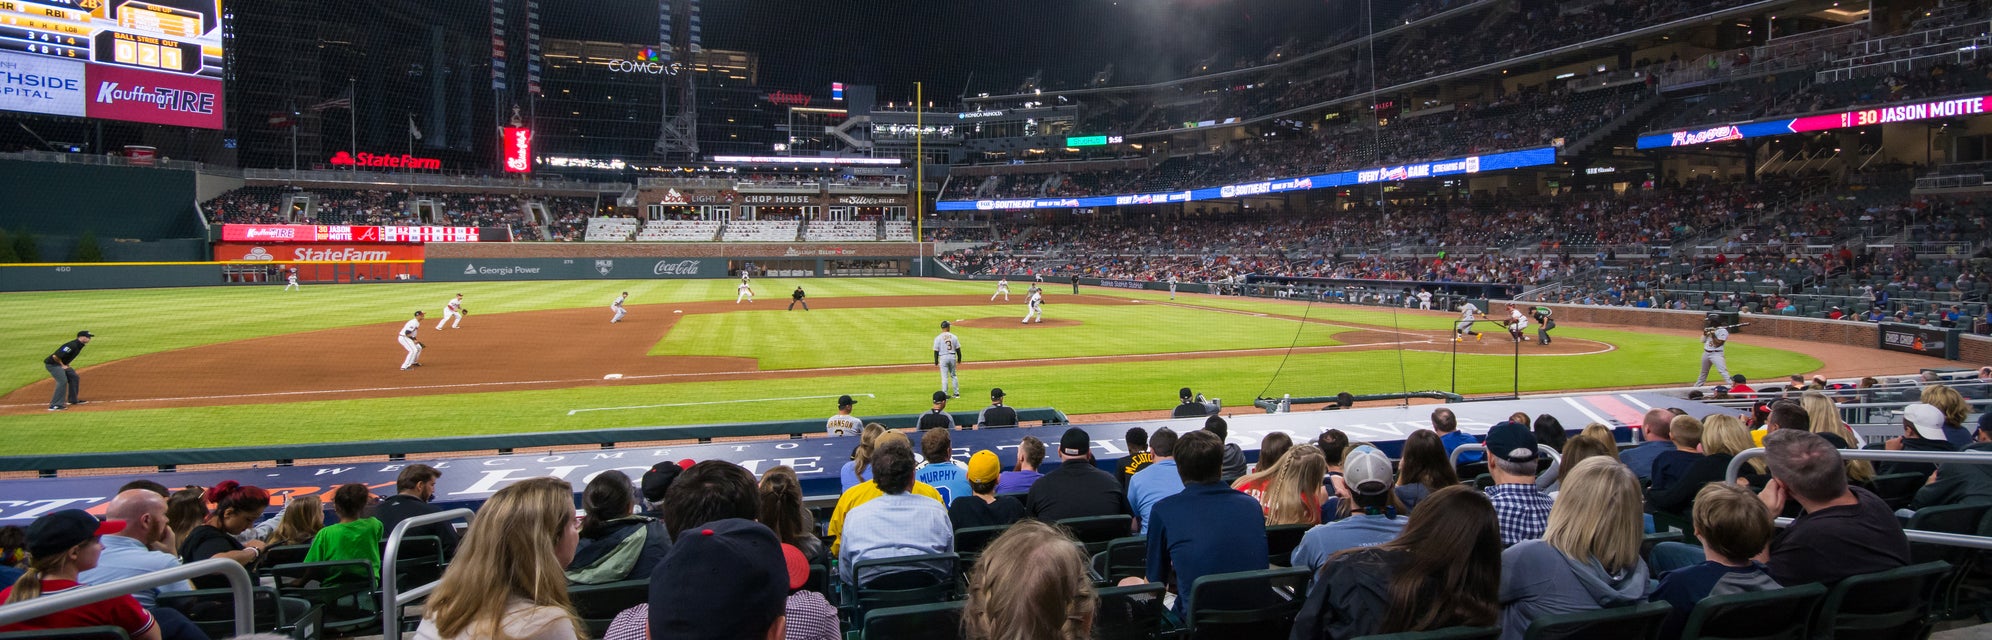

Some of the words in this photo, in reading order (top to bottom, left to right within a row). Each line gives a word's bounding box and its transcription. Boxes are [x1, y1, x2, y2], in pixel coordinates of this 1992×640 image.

[46, 9, 65, 19] RBI
[28, 31, 35, 40] 3
[41, 33, 49, 42] 4
[55, 35, 61, 44] 1
[67, 37, 76, 45] 4
[114, 32, 135, 41] BALL
[137, 36, 159, 45] STRIKE
[28, 44, 36, 52] 4
[41, 46, 48, 54] 8
[55, 48, 61, 56] 1
[67, 49, 75, 57] 5
[118, 43, 132, 60] 0
[142, 47, 157, 63] 2
[166, 51, 177, 67] 1
[608, 60, 682, 76] COMCAS
[96, 81, 175, 107] Kauffman
[155, 87, 215, 115] TIRE
[768, 90, 811, 106] xfinity
[1858, 109, 1878, 125] 30
[1880, 103, 1927, 123] JASON
[1929, 97, 1984, 118] MOTTE
[1108, 136, 1123, 144] 9:56
[1671, 126, 1731, 147] Braves
[1358, 170, 1380, 183] EVERY
[1408, 165, 1430, 178] GAME
[1235, 182, 1271, 196] SOUTHEAST
[691, 195, 717, 203] LIGHT
[745, 195, 772, 203] CHOP
[776, 195, 809, 203] HOUSE
[994, 200, 1035, 209] SOUTHEAST
[1117, 196, 1132, 204] EVERY
[1152, 194, 1168, 203] GAME
[479, 266, 513, 276] Georgia
[515, 266, 541, 275] Power
[945, 340, 953, 351] 3
[731, 441, 800, 453] TO
[919, 470, 957, 484] MURPHY
